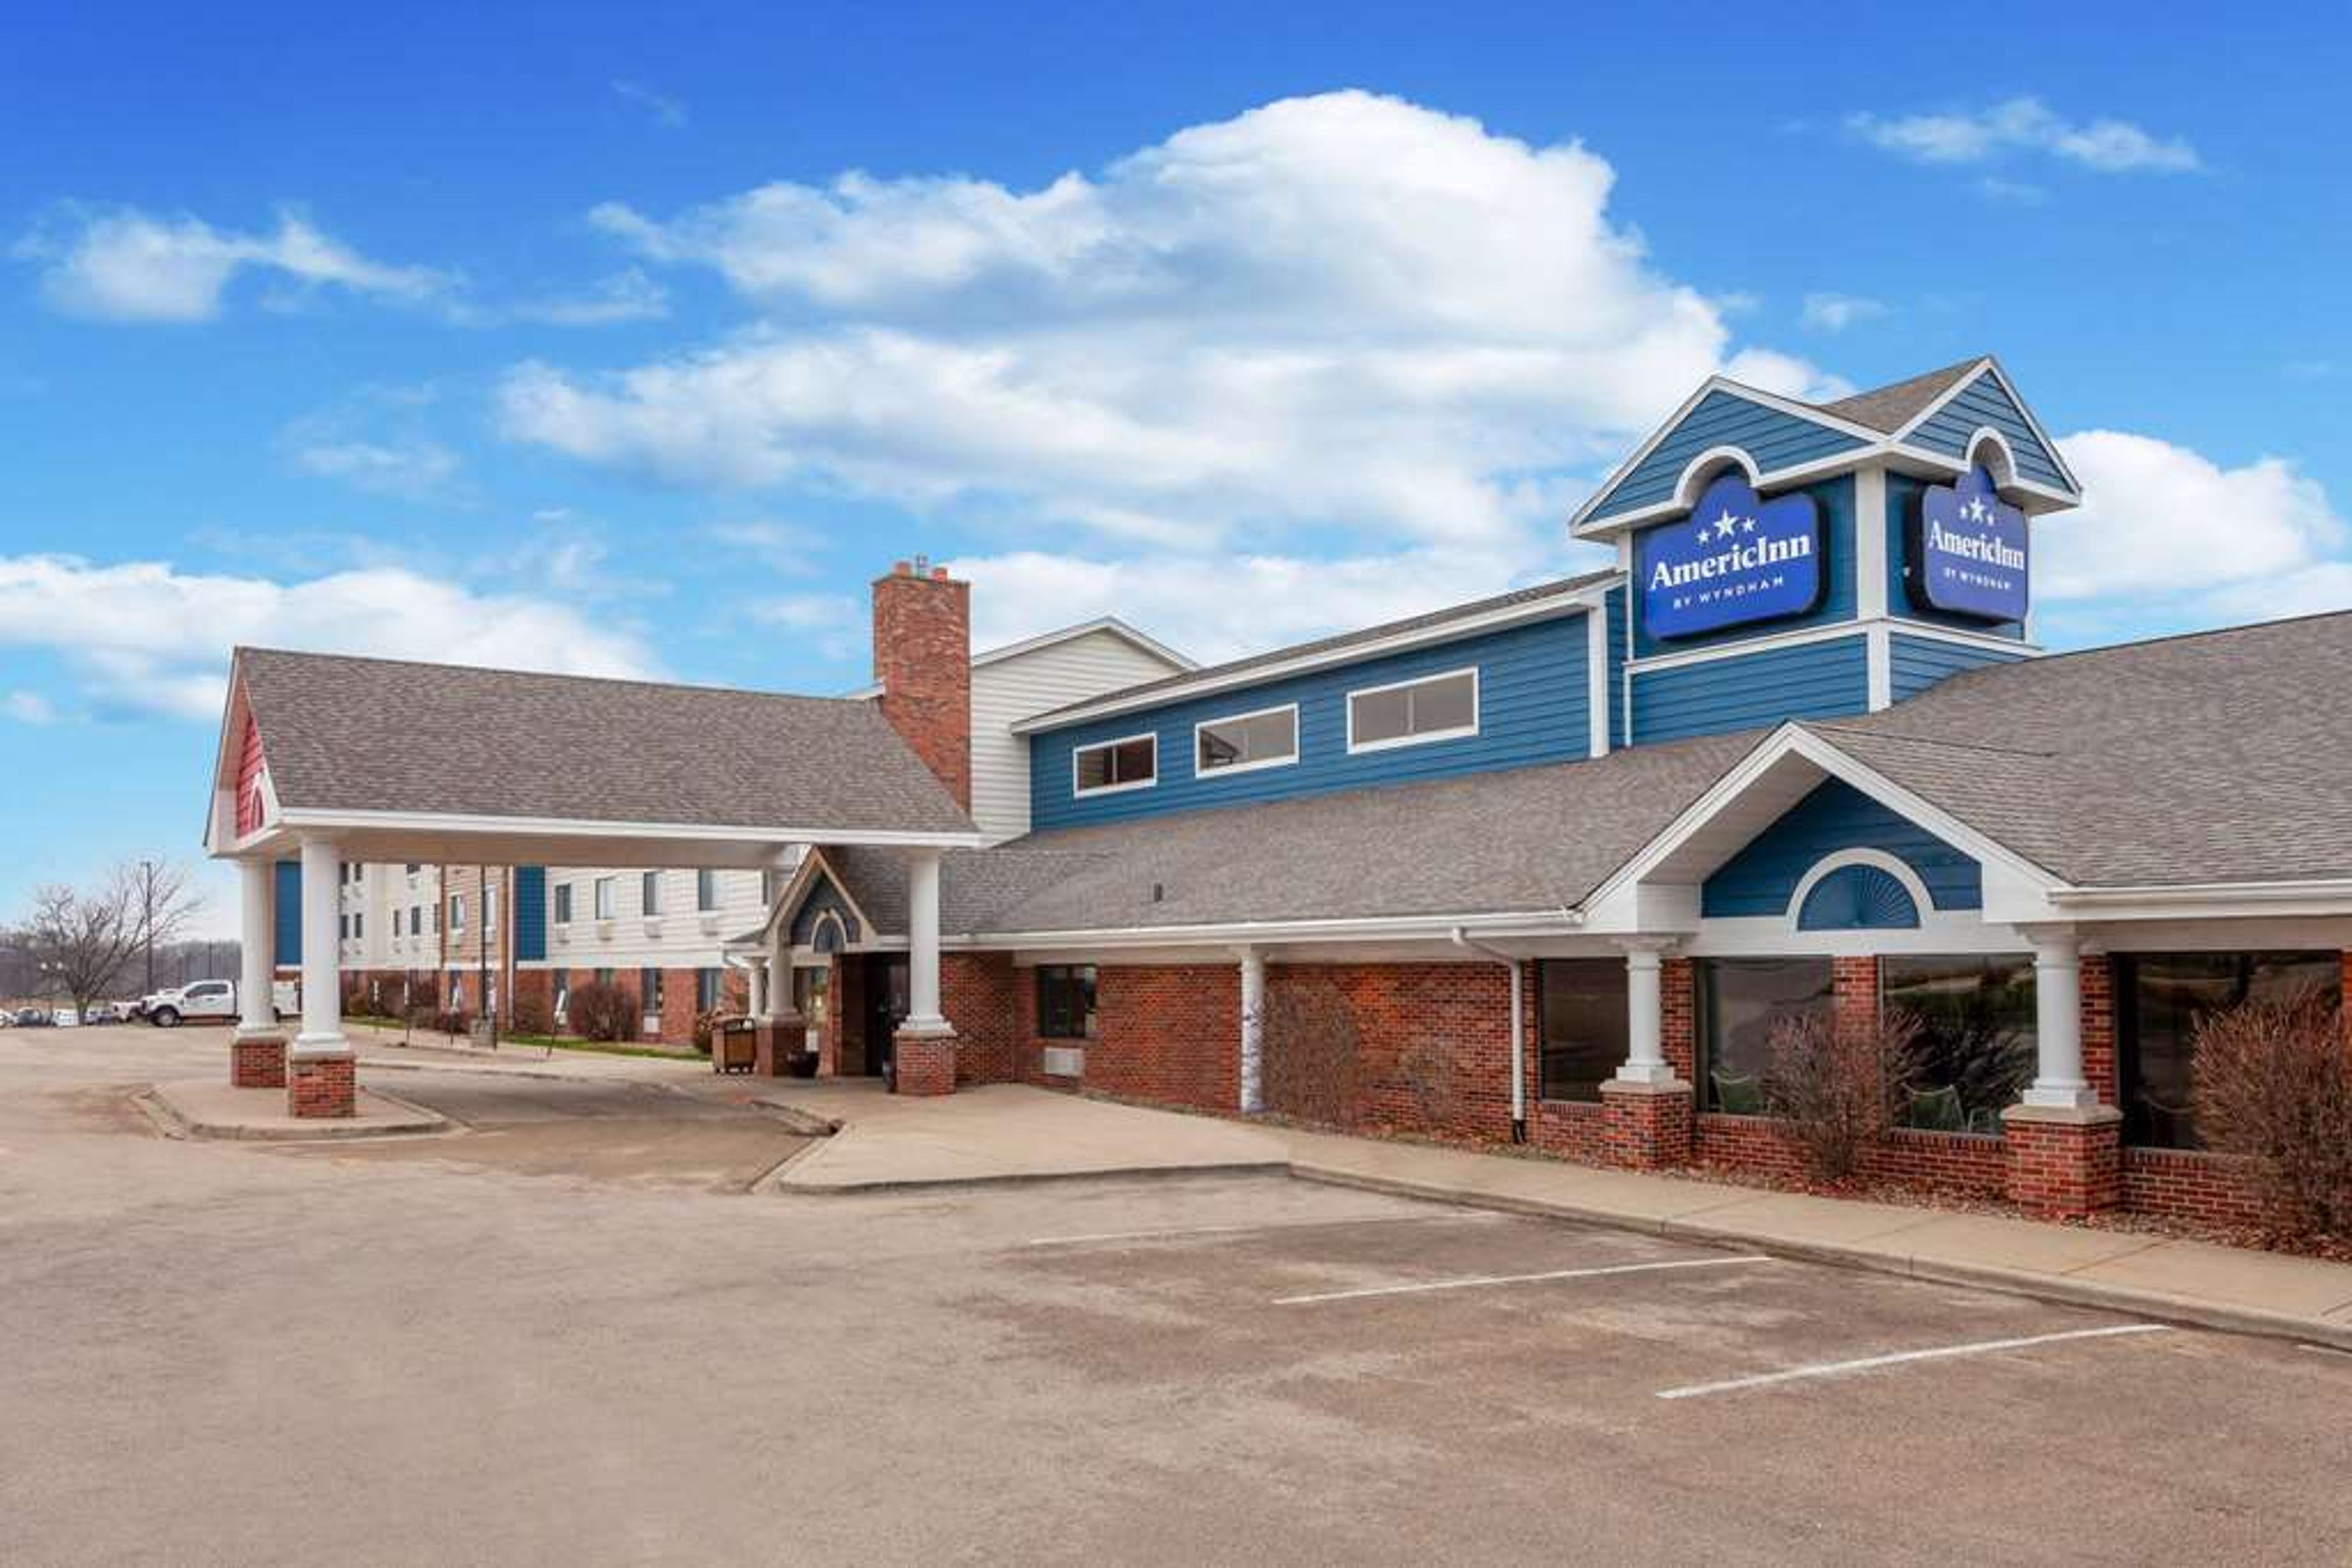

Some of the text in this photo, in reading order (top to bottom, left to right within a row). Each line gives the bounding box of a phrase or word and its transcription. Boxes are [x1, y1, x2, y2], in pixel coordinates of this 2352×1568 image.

[1650, 535, 1811, 590] AmericInn
[1928, 520, 2024, 570] AmericInn
[1673, 576, 1784, 610] BY WYNDHAM
